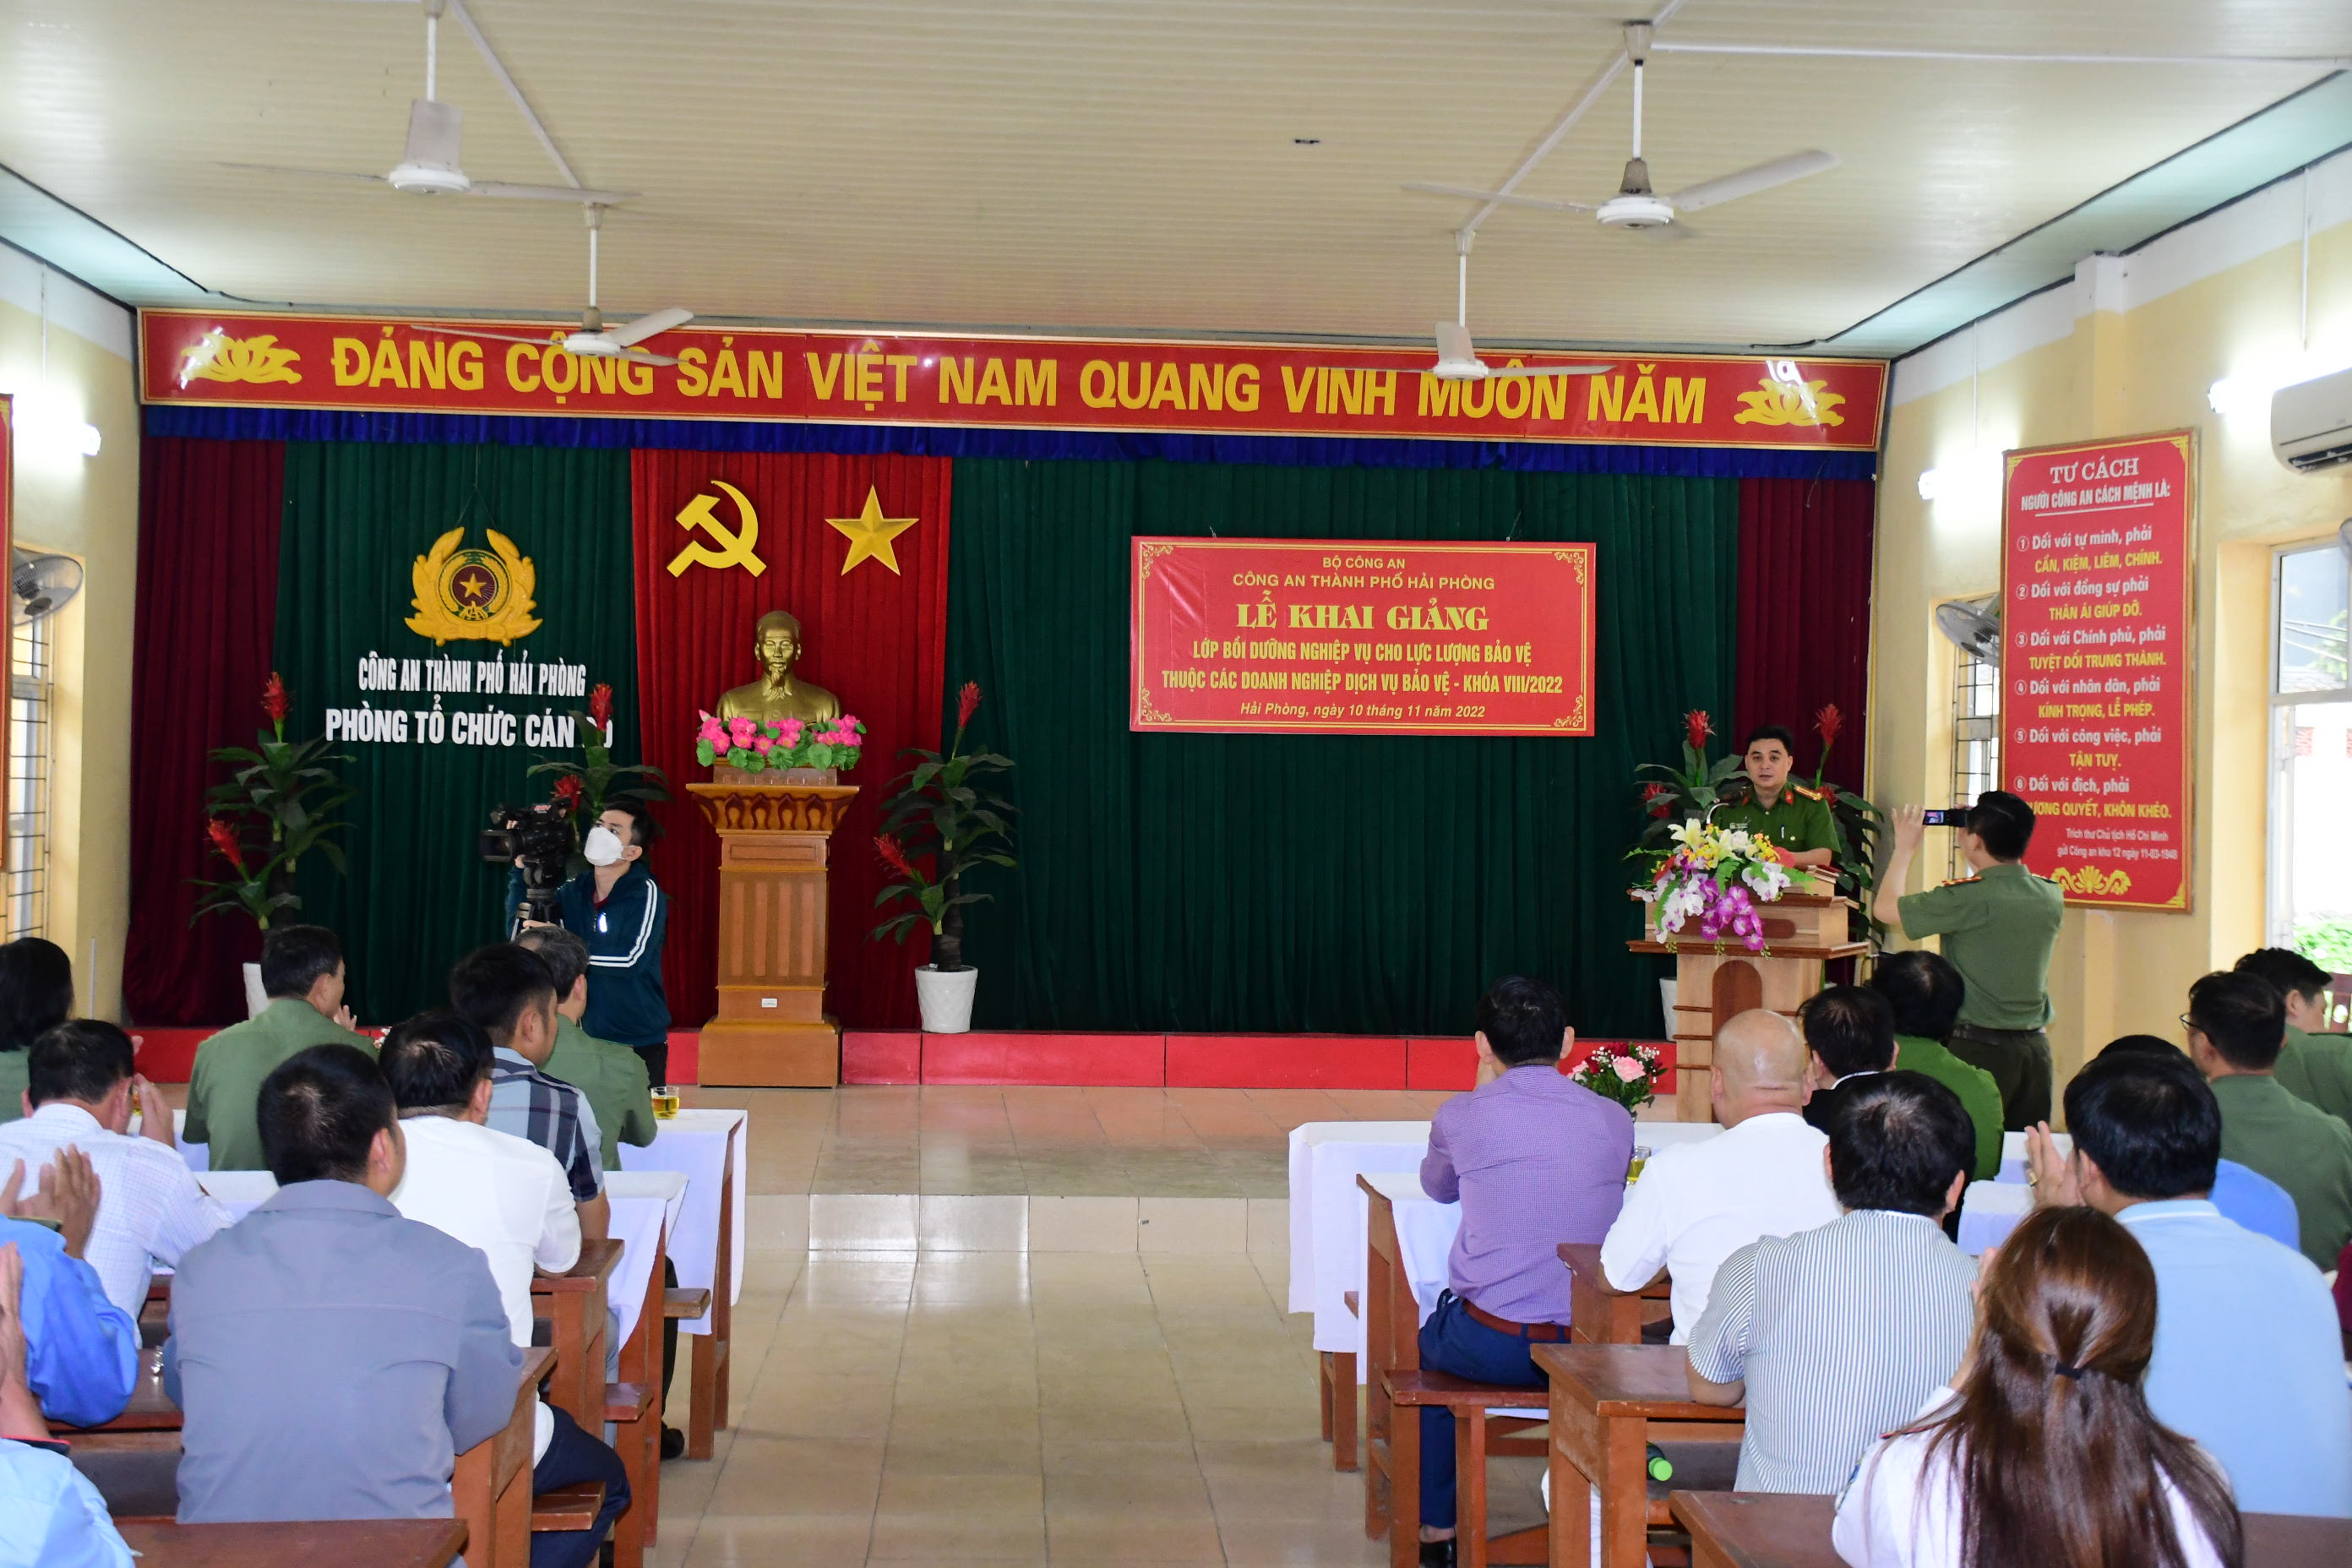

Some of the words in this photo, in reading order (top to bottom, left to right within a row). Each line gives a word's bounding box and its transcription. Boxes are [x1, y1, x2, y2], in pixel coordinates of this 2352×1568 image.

[331, 327, 484, 391] ĐẢNG
[505, 331, 654, 404] CỘNG
[677, 336, 783, 399] SẢN
[808, 340, 917, 411] VIỆT
[939, 357, 1057, 406] NAM
[1080, 359, 1260, 412] QUANG
[1281, 366, 1397, 416] VINH
[1418, 358, 1568, 420] MUÔN
[1586, 365, 1706, 425] NĂM
[2050, 461, 2079, 484] TƯ
[2082, 455, 2139, 481] CÁCH
[2051, 489, 2077, 508] CÔNG
[2079, 489, 2093, 505] AN
[2094, 485, 2121, 504] CÁCH
[2123, 481, 2153, 504] MỆNH
[2055, 533, 2072, 547] với
[2074, 533, 2088, 550] tự
[2126, 525, 2152, 546] phải
[1322, 555, 1342, 570] BỘ
[1345, 556, 1384, 569] CÔNG
[1386, 558, 1406, 569] AN
[1233, 571, 1279, 586] CÔNG
[1284, 575, 1305, 587] AN
[1311, 573, 1364, 588] THÀNH
[1369, 572, 1403, 589] PHỐ
[1407, 573, 1434, 589] HẢI
[1439, 574, 1494, 590] PHÒNG
[2054, 582, 2071, 596] với
[2123, 574, 2149, 594] phải
[1236, 590, 1277, 629] LỄ
[1288, 604, 1375, 629] KHAI
[1386, 597, 1489, 631] GIẢNG
[2053, 630, 2070, 645] với
[2138, 623, 2166, 645] phải
[1193, 638, 1219, 659] LỚP
[1300, 640, 1349, 664] NGHIỆP
[1354, 643, 1371, 665] VỤ
[1375, 644, 1402, 662] CHO
[1407, 643, 1431, 666] LỰC
[1436, 643, 1480, 666] LƯỢNG
[1484, 640, 1511, 663] BẢO
[1516, 641, 1532, 667] VỆ
[2084, 653, 2122, 668] TRUNG
[358, 651, 397, 692] CÔNG
[400, 659, 421, 692] AN
[426, 653, 471, 693] THÀNH
[476, 649, 504, 694] PHỐ
[509, 650, 533, 695] HẢI
[538, 656, 586, 697] PHÒNG
[1162, 667, 1206, 692] THUỘC
[1210, 668, 1238, 689] CÁC
[1241, 672, 1288, 690] DOANH
[1291, 669, 1342, 694] NGHIỆP
[1345, 673, 1377, 694] DỊCH
[1380, 673, 1398, 694] VỤ
[1402, 668, 1429, 692] BẢO
[1434, 672, 1450, 695] VỆ
[1463, 672, 1500, 693] KHÓA
[1504, 676, 1563, 694] VIII/2022
[2052, 678, 2069, 694] với
[2072, 678, 2101, 694] nhân
[2133, 676, 2160, 695] phải
[1240, 700, 1260, 715] Hải
[1265, 703, 1309, 718] Phòng,
[1314, 705, 1344, 718] ngày
[1349, 705, 1363, 716] 10
[1367, 704, 1402, 719] tháng
[1407, 705, 1420, 716] 11
[1424, 705, 1451, 717] năm
[1456, 705, 1485, 717] 2022
[325, 700, 408, 743] PHÒNG
[414, 694, 445, 744] TỔ
[451, 705, 516, 747] CHỨC
[525, 707, 575, 749] CÁN
[2052, 727, 2069, 743] với
[2072, 727, 2101, 746] công
[2135, 726, 2162, 744] phải
[2051, 776, 2069, 792] với
[2103, 776, 2130, 795] phải
